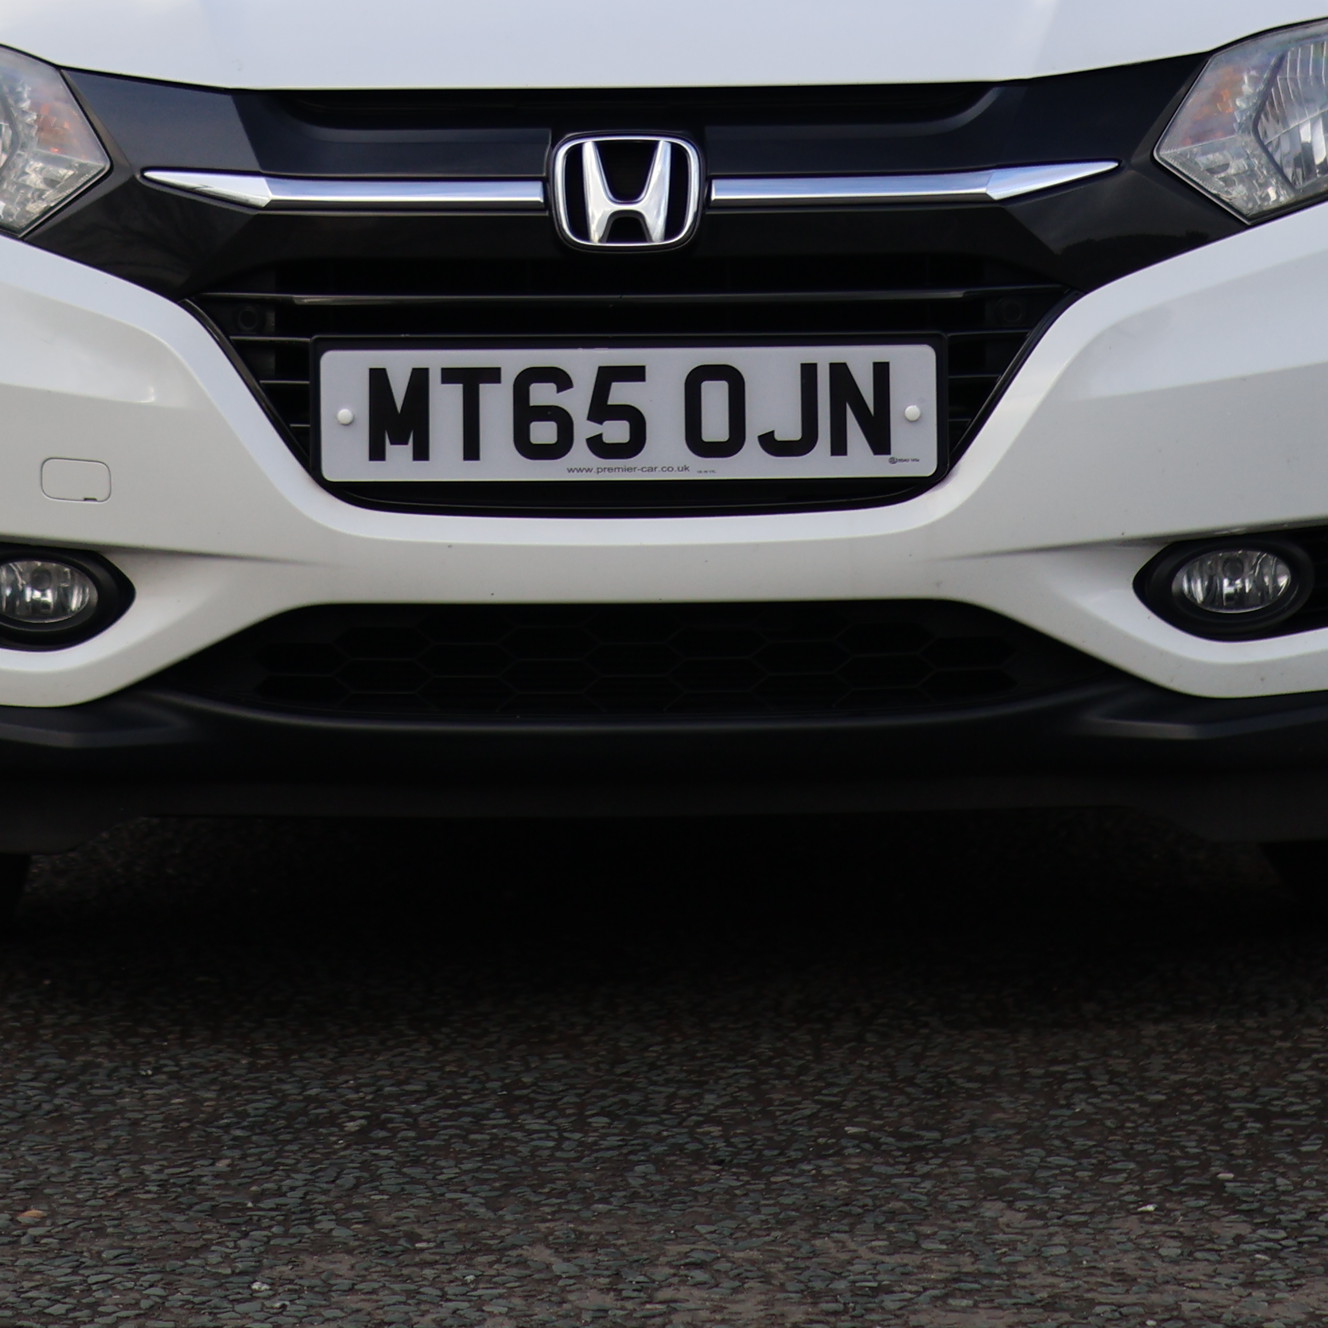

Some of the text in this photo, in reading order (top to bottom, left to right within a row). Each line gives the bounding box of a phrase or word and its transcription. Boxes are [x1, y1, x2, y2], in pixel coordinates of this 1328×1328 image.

[368, 361, 892, 462] MT65 OJN
[566, 464, 691, 475] www.premier-car.co.uk
